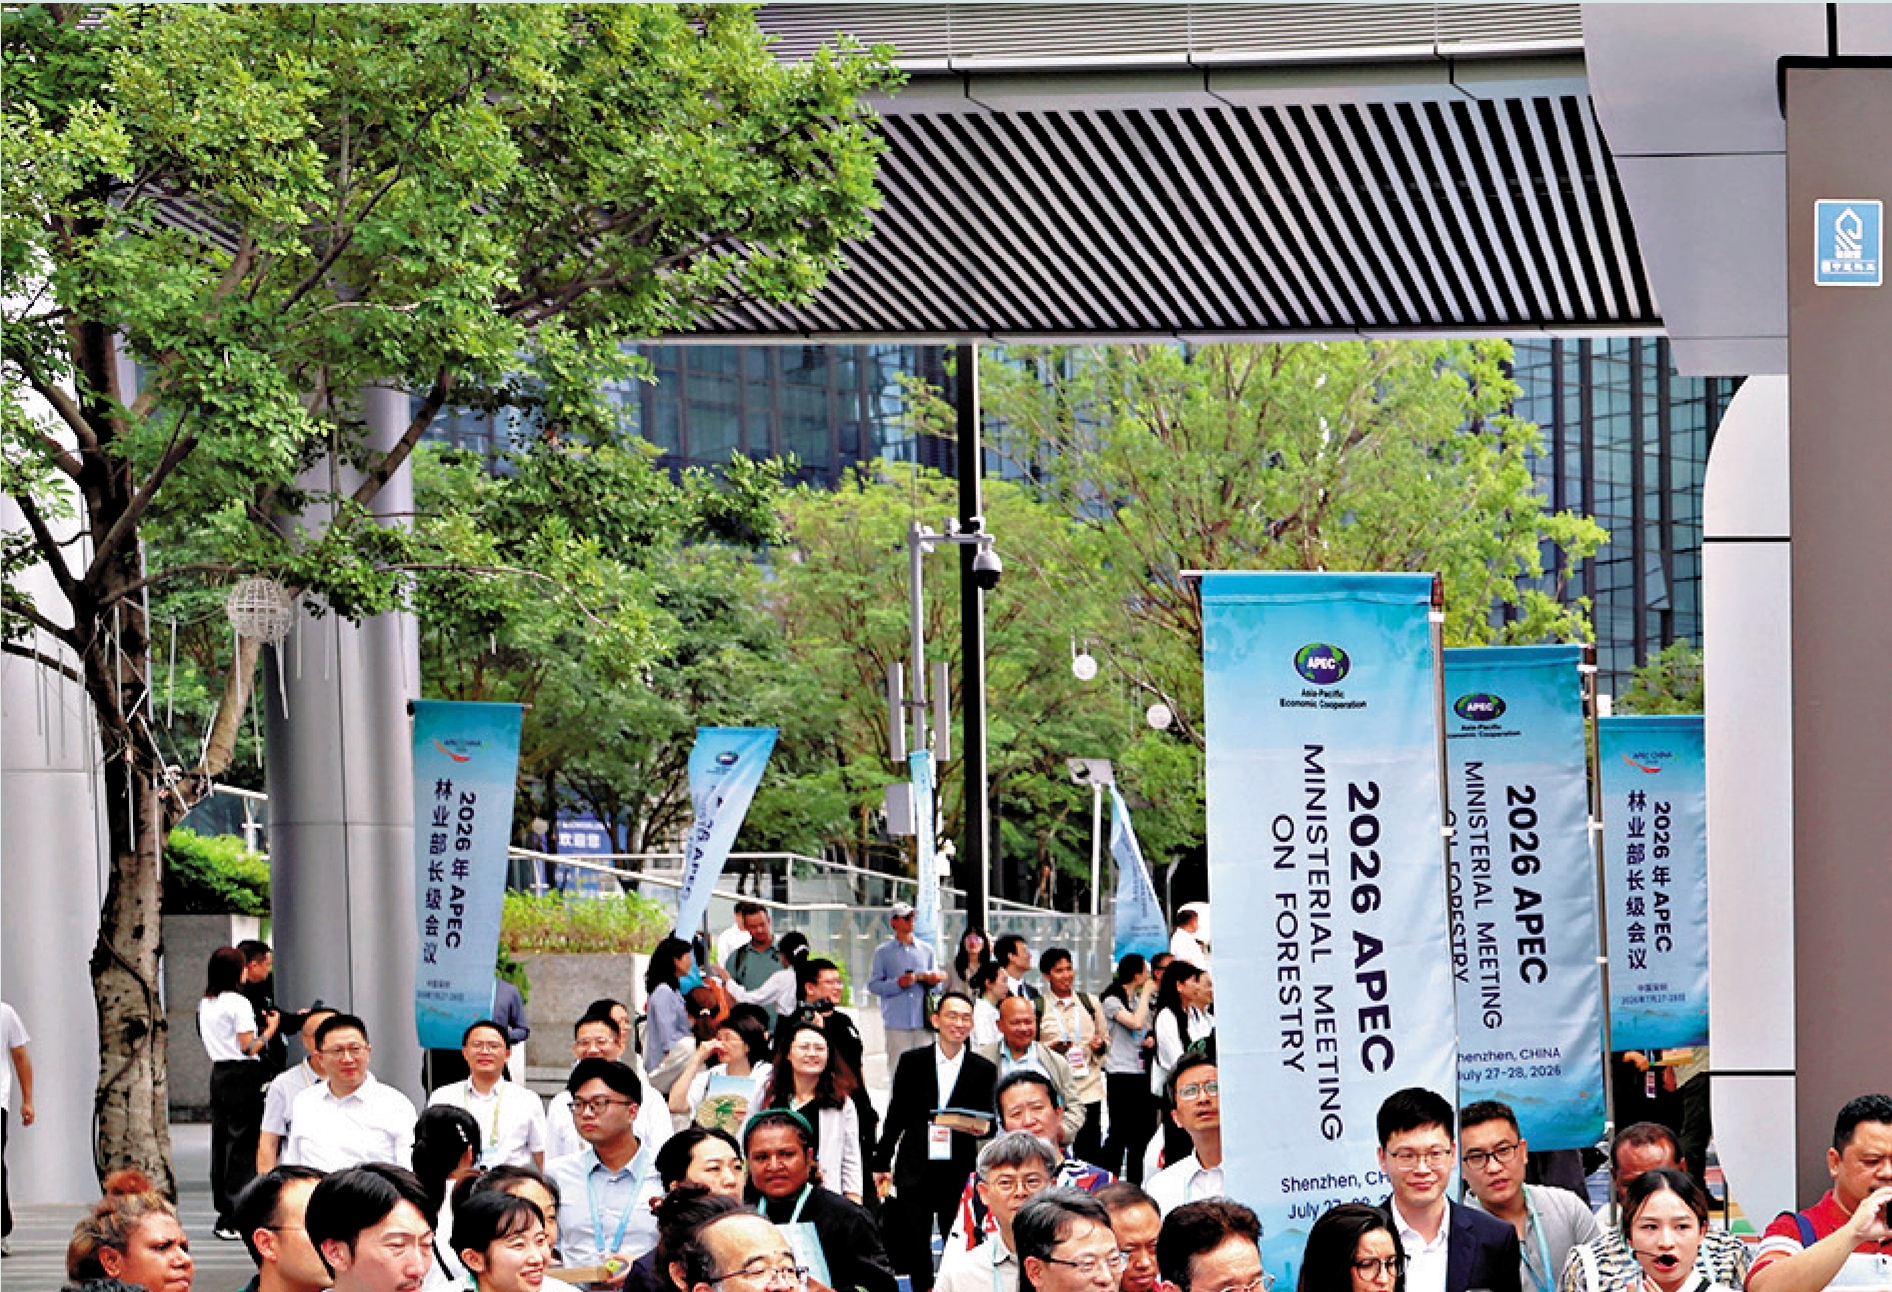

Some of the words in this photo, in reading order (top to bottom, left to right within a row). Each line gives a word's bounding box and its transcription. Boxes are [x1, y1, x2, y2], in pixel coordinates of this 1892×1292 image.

[1279, 698, 1318, 709] Economic
[1320, 699, 1368, 711] Cooperation
[1301, 688, 1346, 699] Asia-Pacific
[1307, 656, 1336, 670] APEC
[1466, 702, 1494, 712] APEC
[1272, 813, 1297, 870] ON
[1303, 744, 1332, 964] MINISTERIAL
[1348, 780, 1383, 915] 2026
[1465, 761, 1495, 910] MINISTERIAL
[1507, 784, 1541, 877] 2026
[1626, 789, 1648, 970] 林业部长级会议
[1275, 892, 1306, 1073] FORESTRY
[1476, 921, 1503, 1030] MEETING
[1513, 886, 1549, 985] APEC
[1353, 929, 1396, 1074] APEC
[1312, 984, 1344, 1141] MEETING
[1457, 1049, 1518, 1063] henzhen,
[1519, 1046, 1561, 1060] CHINA
[1529, 1064, 1562, 1078] 2026
[1281, 1172, 1362, 1194] Shenzhen,
